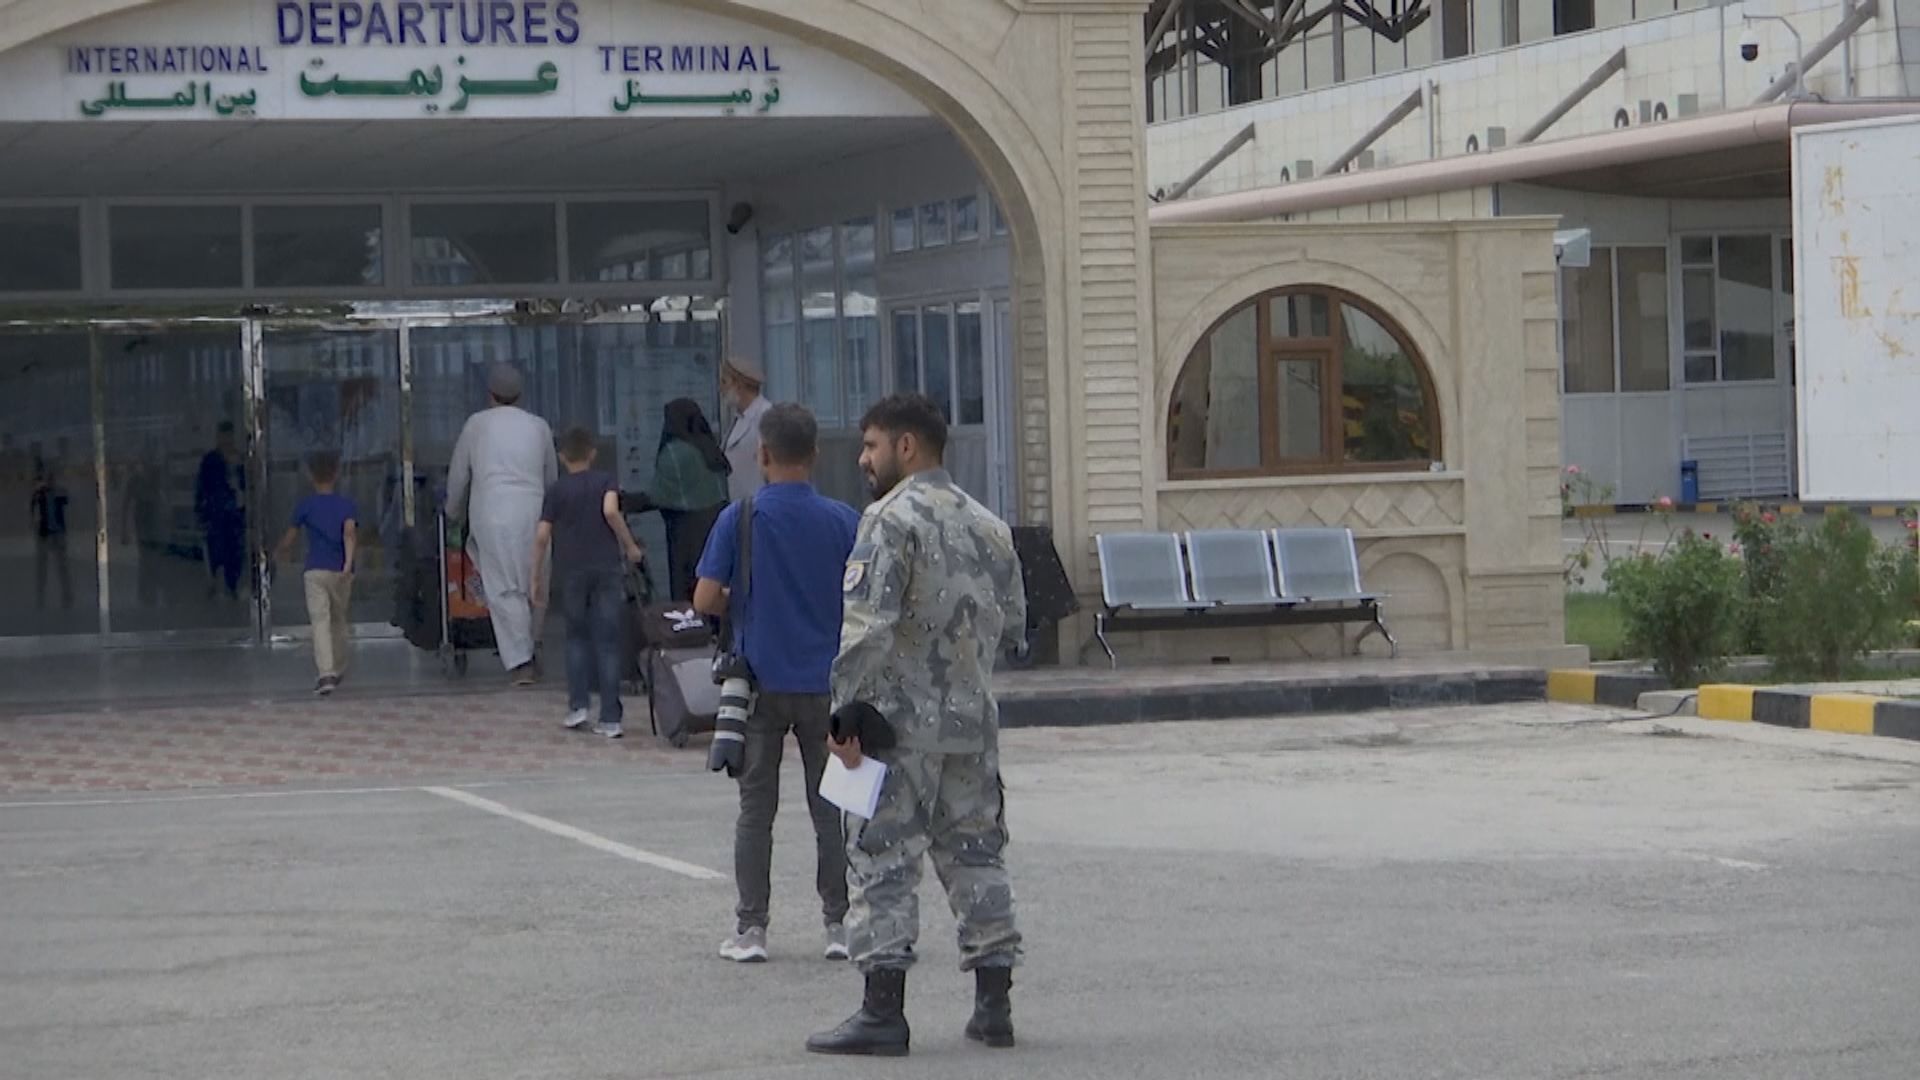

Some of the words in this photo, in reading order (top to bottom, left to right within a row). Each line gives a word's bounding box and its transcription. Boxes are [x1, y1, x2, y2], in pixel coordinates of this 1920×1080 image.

[276, 0, 580, 45] DEPARTURES
[68, 46, 268, 72] INTERNATIONAL
[599, 46, 781, 72] TERMINAL
